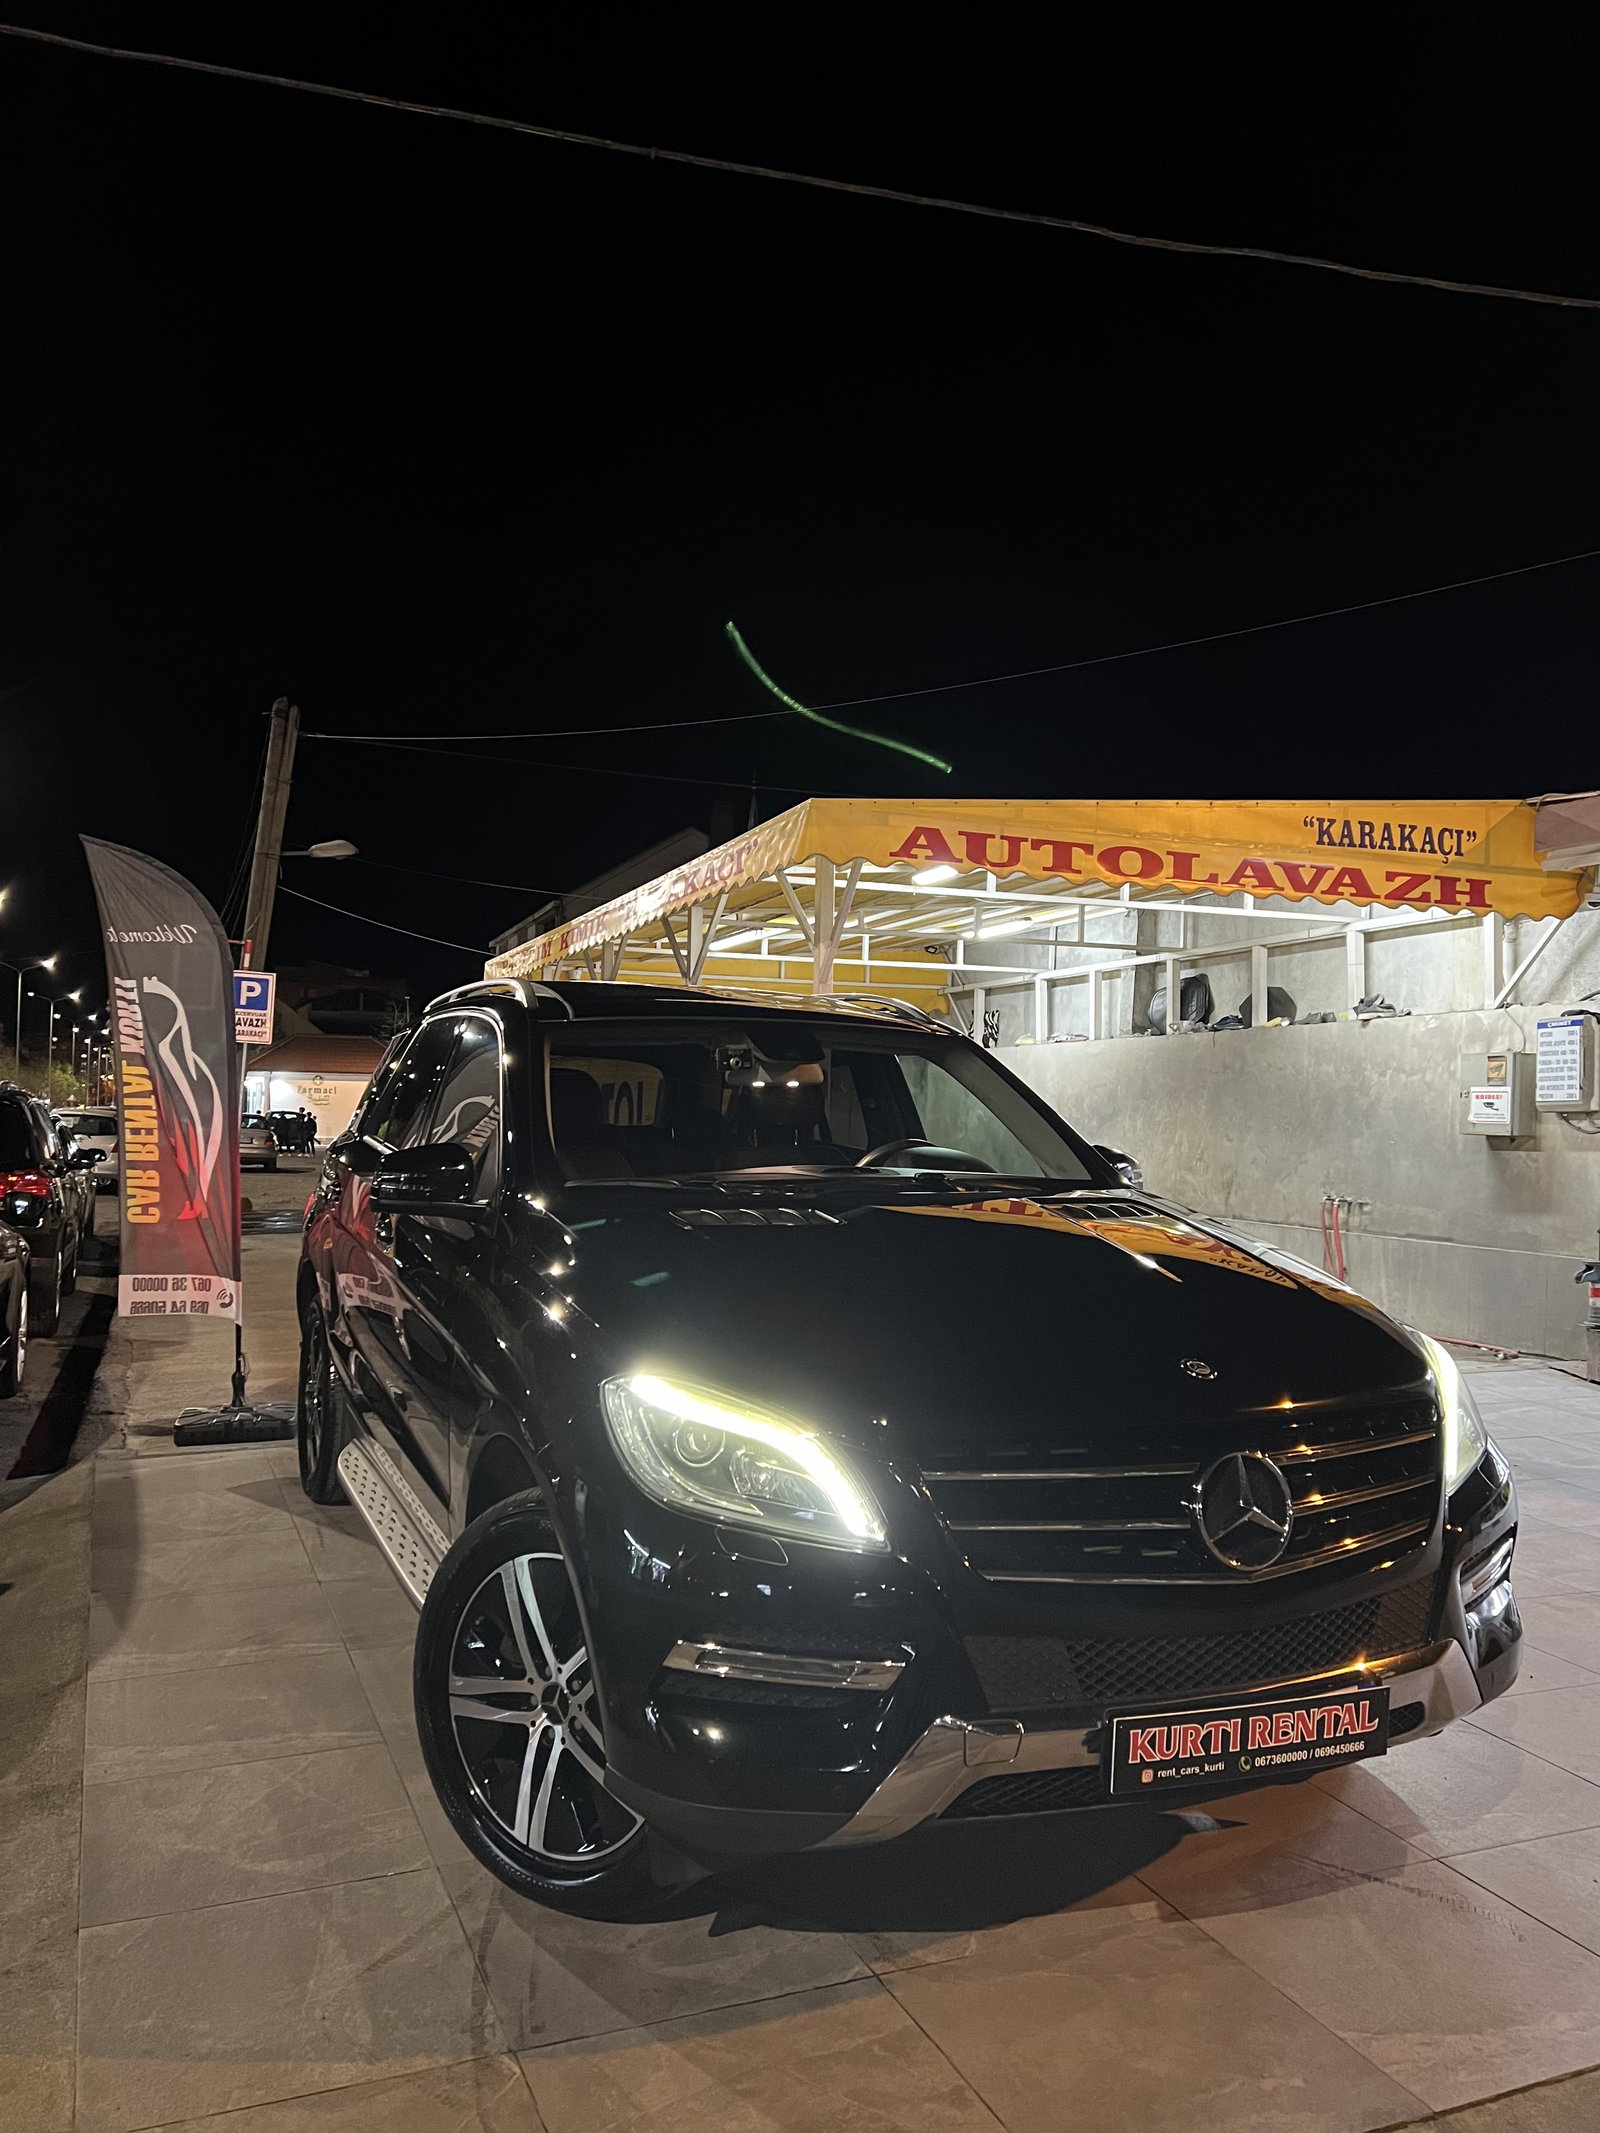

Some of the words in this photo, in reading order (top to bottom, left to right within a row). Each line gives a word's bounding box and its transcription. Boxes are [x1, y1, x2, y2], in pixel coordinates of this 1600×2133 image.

[1303, 816, 1478, 865] “KARAKAÇI”
[890, 826, 1492, 909] AUTOLAVAZH
[240, 980, 262, 1006] P
[235, 1017, 267, 1028] AVAZH
[1128, 1718, 1242, 1764] KURTI
[1248, 1700, 1379, 1751] RENTAL
[1157, 1761, 1225, 1779] rent_cars_kurti
[1254, 1751, 1308, 1768] 0673600000
[1315, 1741, 1365, 1759] 0696450666
